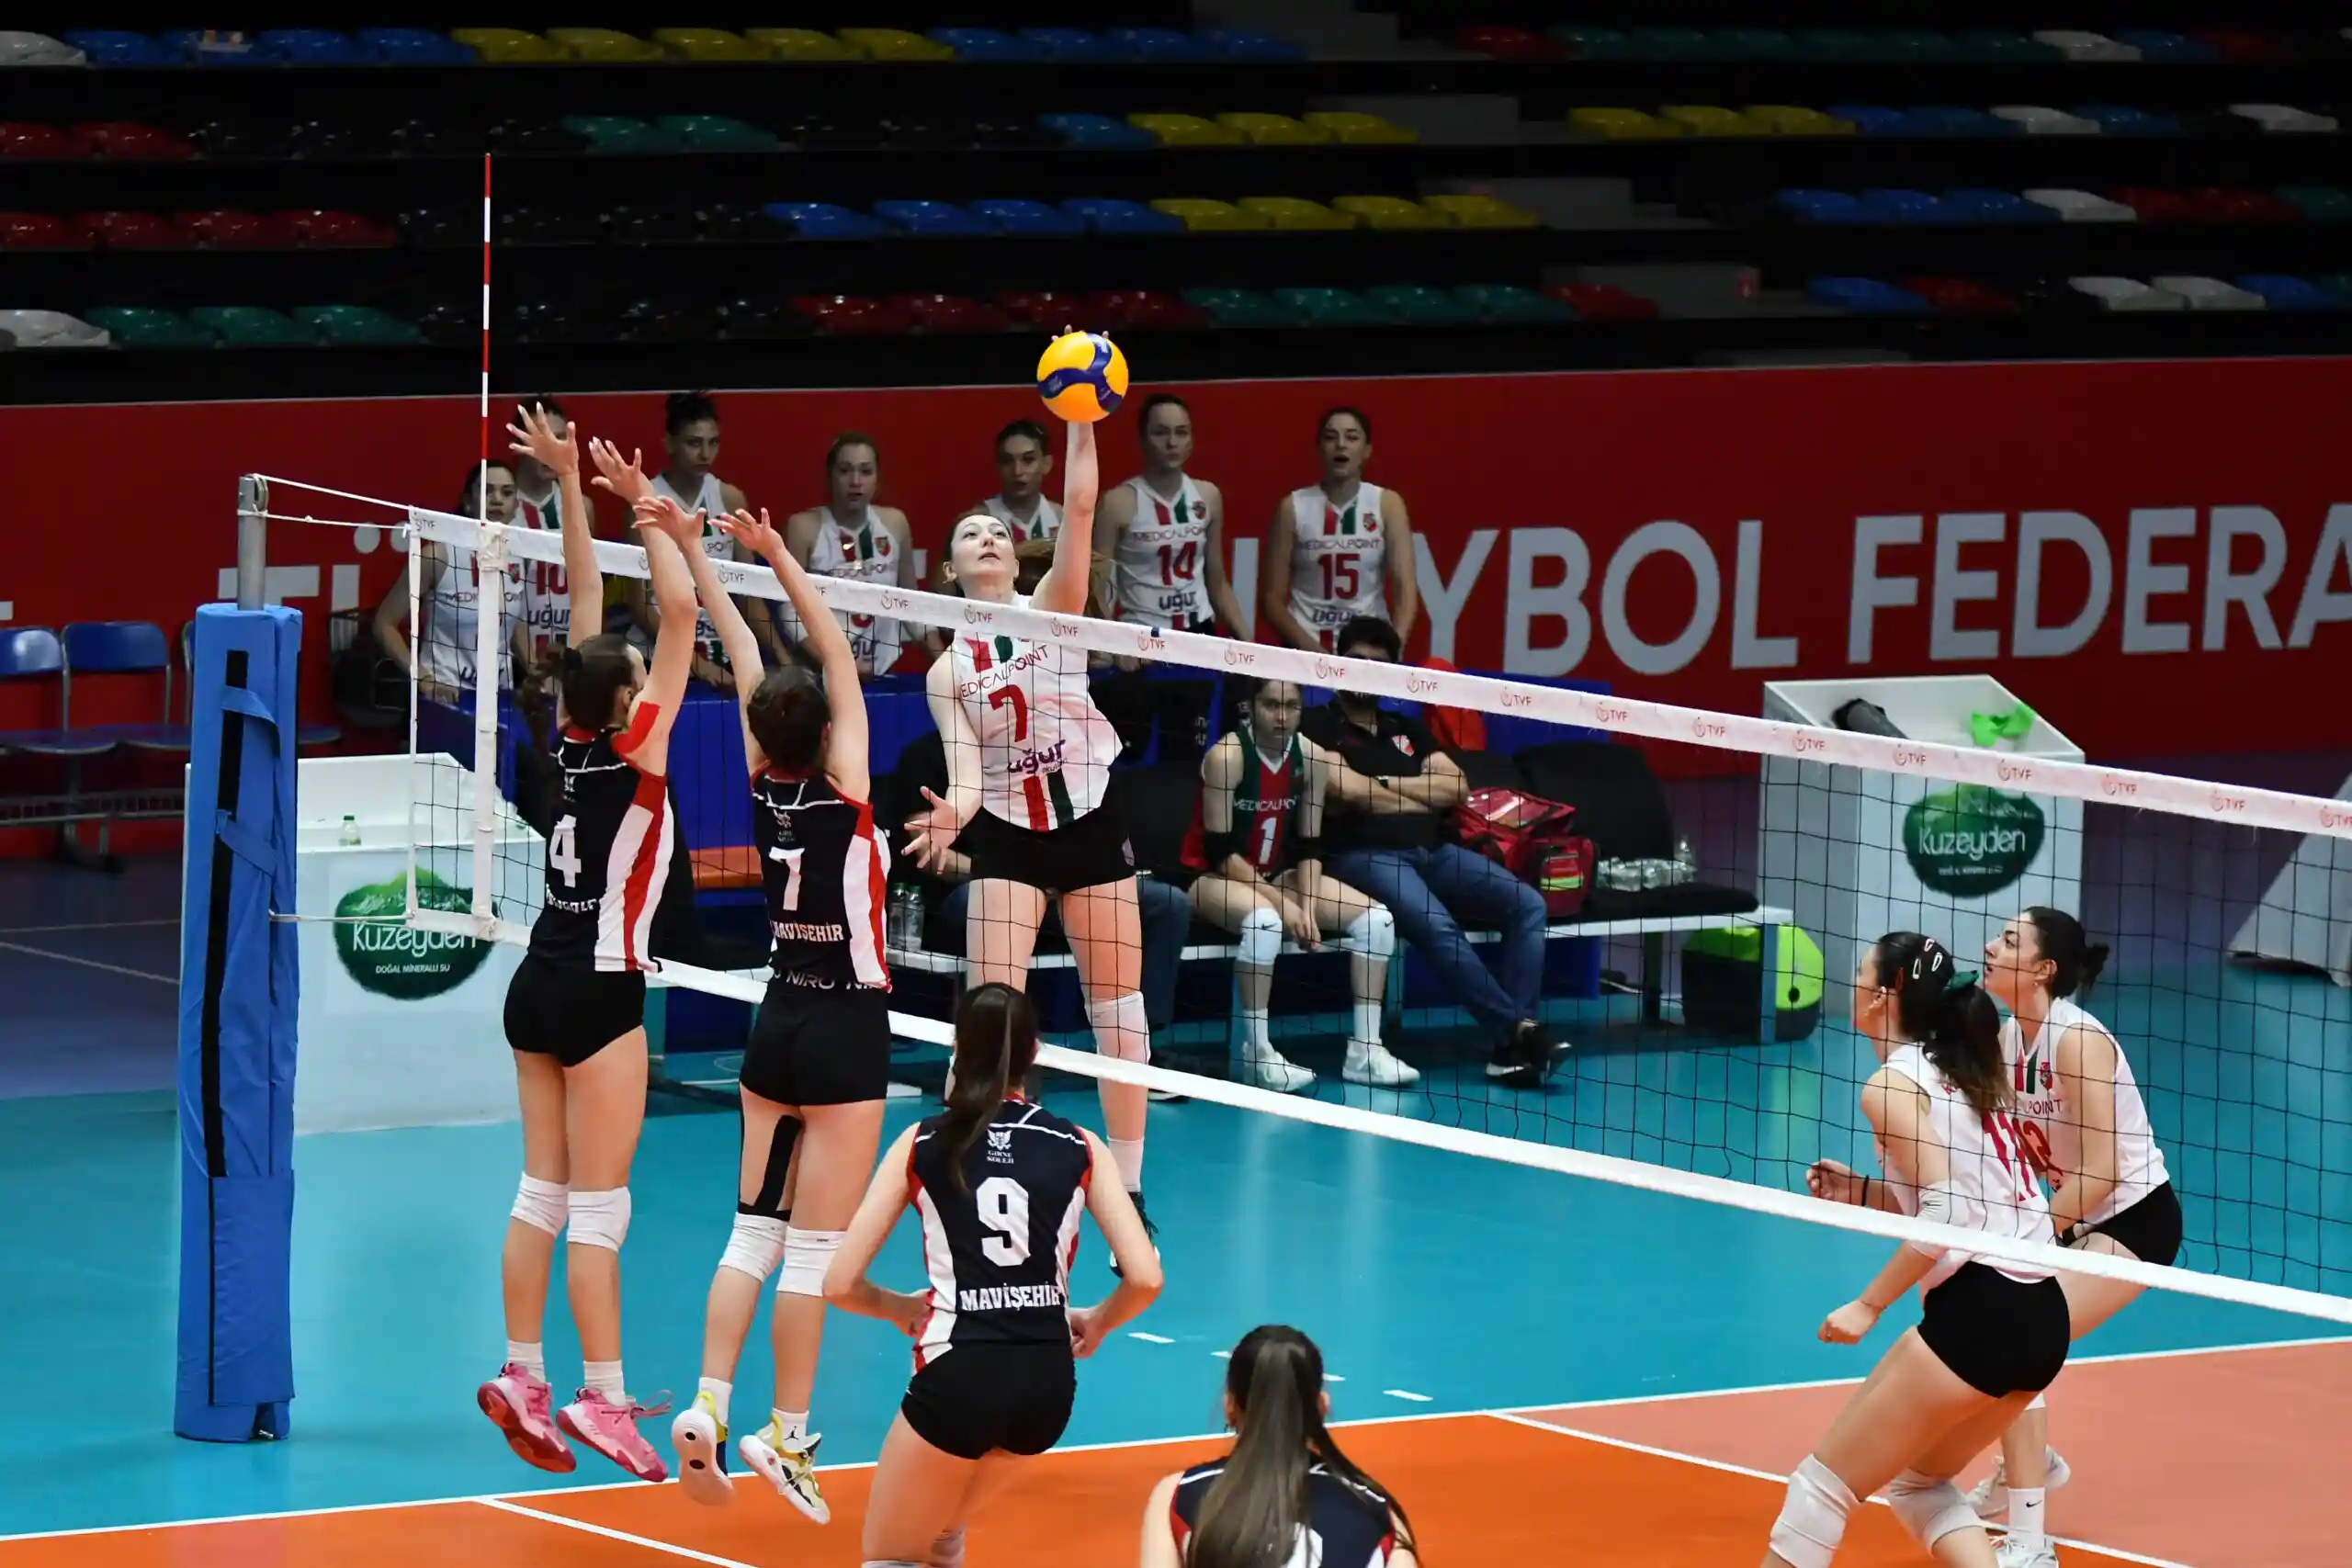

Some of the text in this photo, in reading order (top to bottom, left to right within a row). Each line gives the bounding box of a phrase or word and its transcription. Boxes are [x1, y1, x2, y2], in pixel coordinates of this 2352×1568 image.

[1158, 541, 1197, 586] 14
[1318, 553, 1361, 600] 15
[893, 599, 909, 609] TVF
[977, 612, 992, 622] TVF
[1062, 627, 1079, 637] TVF
[1149, 638, 1165, 649] TVF
[1238, 653, 1254, 663] TVF
[961, 644, 1048, 698] EDICALPOINT
[1329, 667, 1344, 677] TVF
[1421, 681, 1438, 692] TVF
[1514, 694, 1531, 705] TVF
[988, 684, 1028, 742] 7
[1611, 709, 1627, 720] TVF
[1707, 724, 1724, 735] TVF
[1807, 739, 1825, 750] TVF
[1908, 753, 1926, 763] TVF
[2012, 767, 2031, 779] TVF
[2118, 782, 2136, 794] TVF
[2226, 798, 2245, 810] TVF
[1259, 817, 1277, 864] 1
[1918, 825, 2026, 861] Kuzeyden
[549, 814, 582, 888] 4
[769, 846, 805, 911] 7
[976, 1177, 1031, 1267] 9
